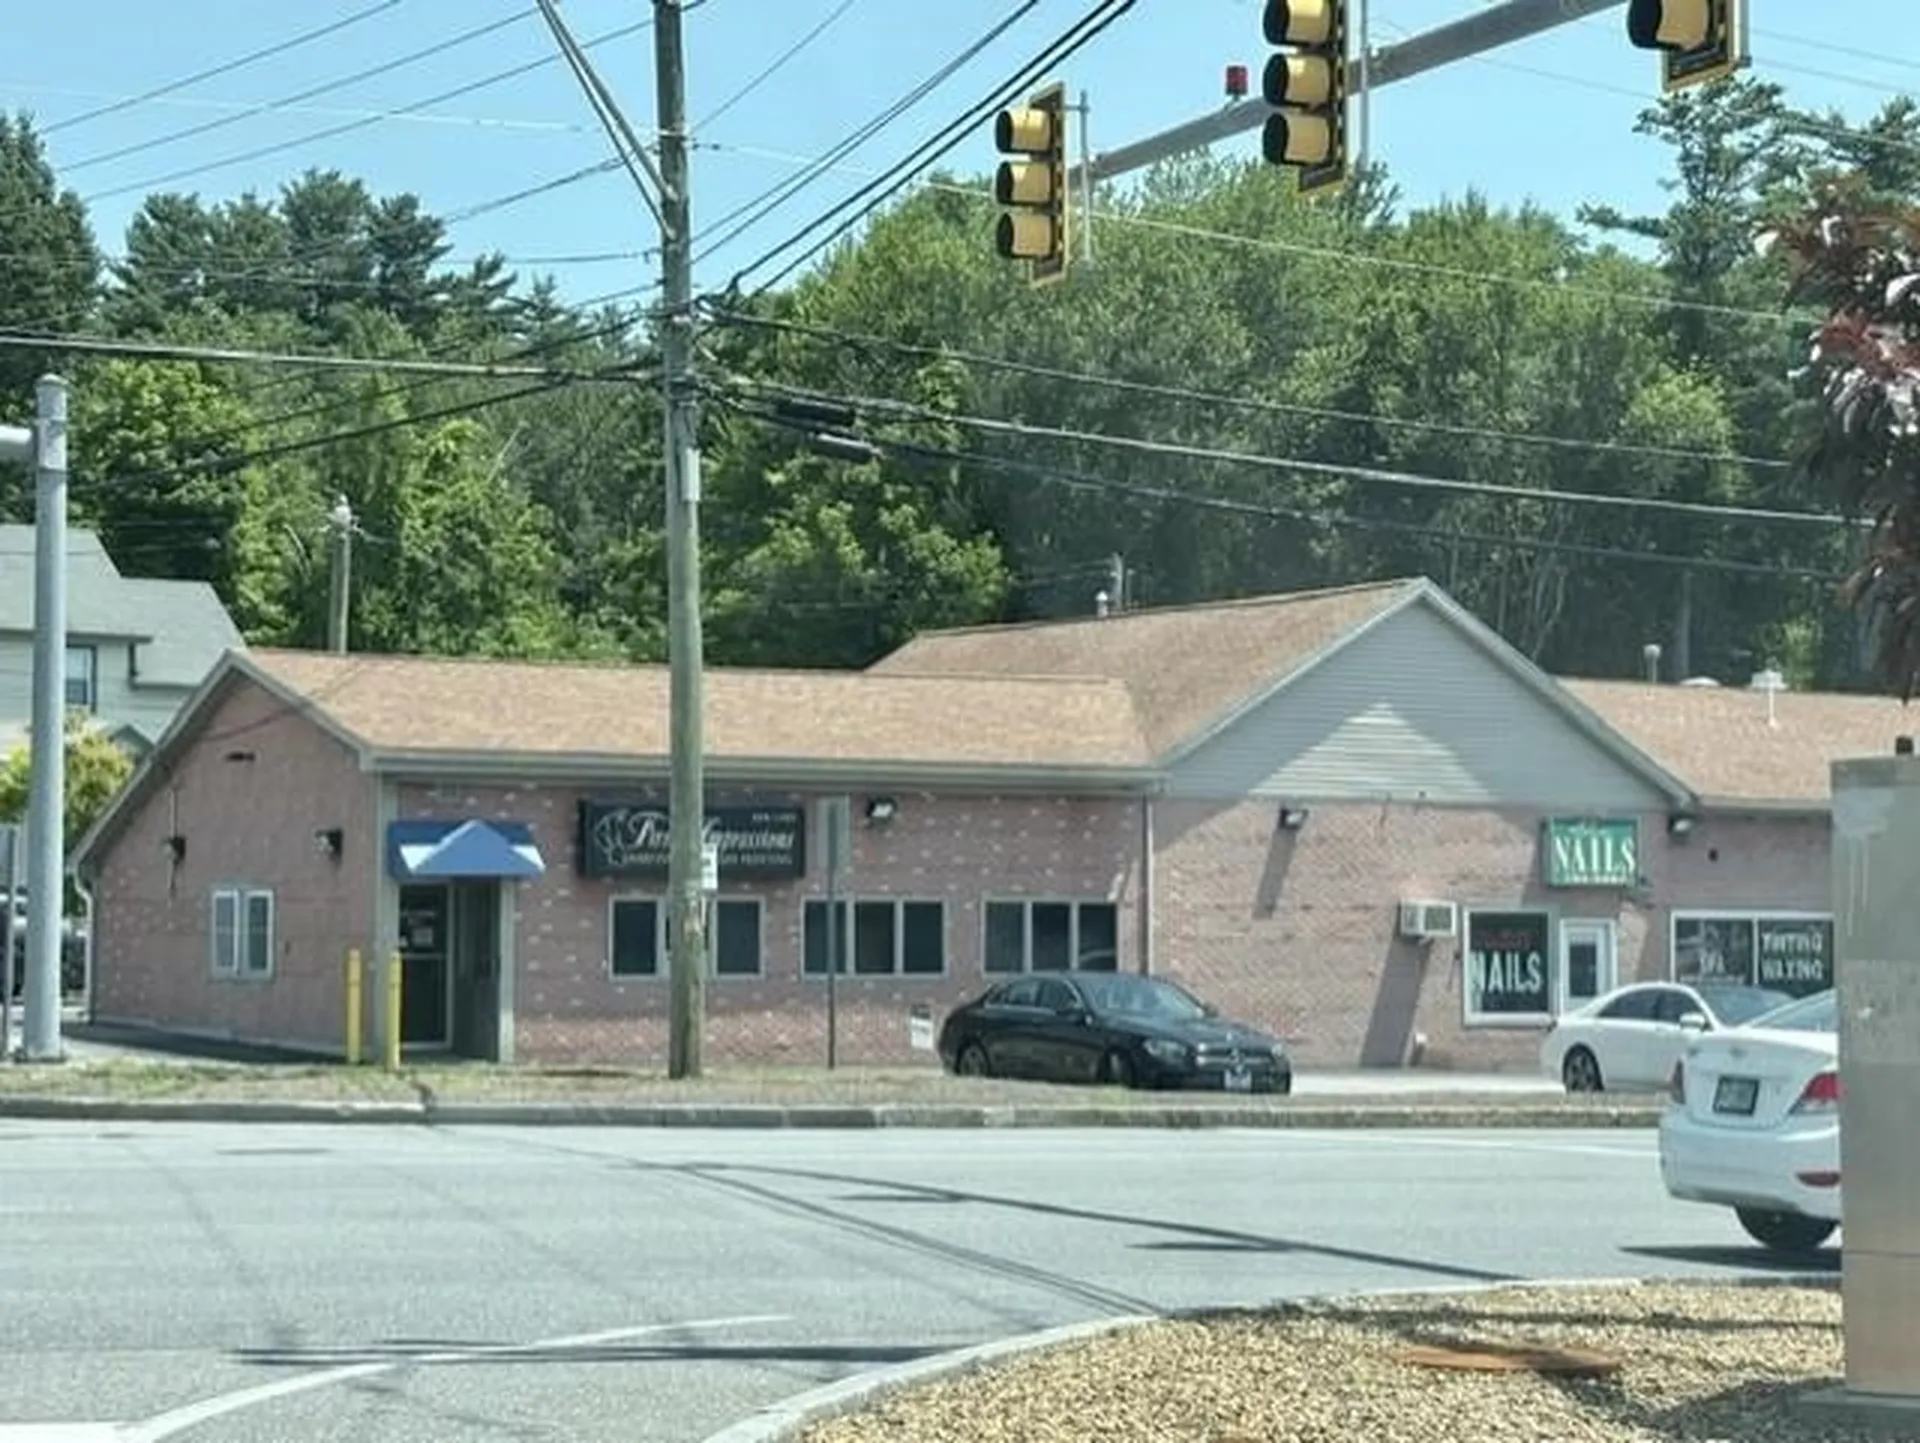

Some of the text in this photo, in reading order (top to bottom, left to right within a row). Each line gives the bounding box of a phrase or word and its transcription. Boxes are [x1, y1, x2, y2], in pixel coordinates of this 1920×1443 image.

[1554, 836, 1636, 874] NAILS
[1470, 950, 1541, 994] NAILS
[1762, 958, 1823, 980] WAXING
